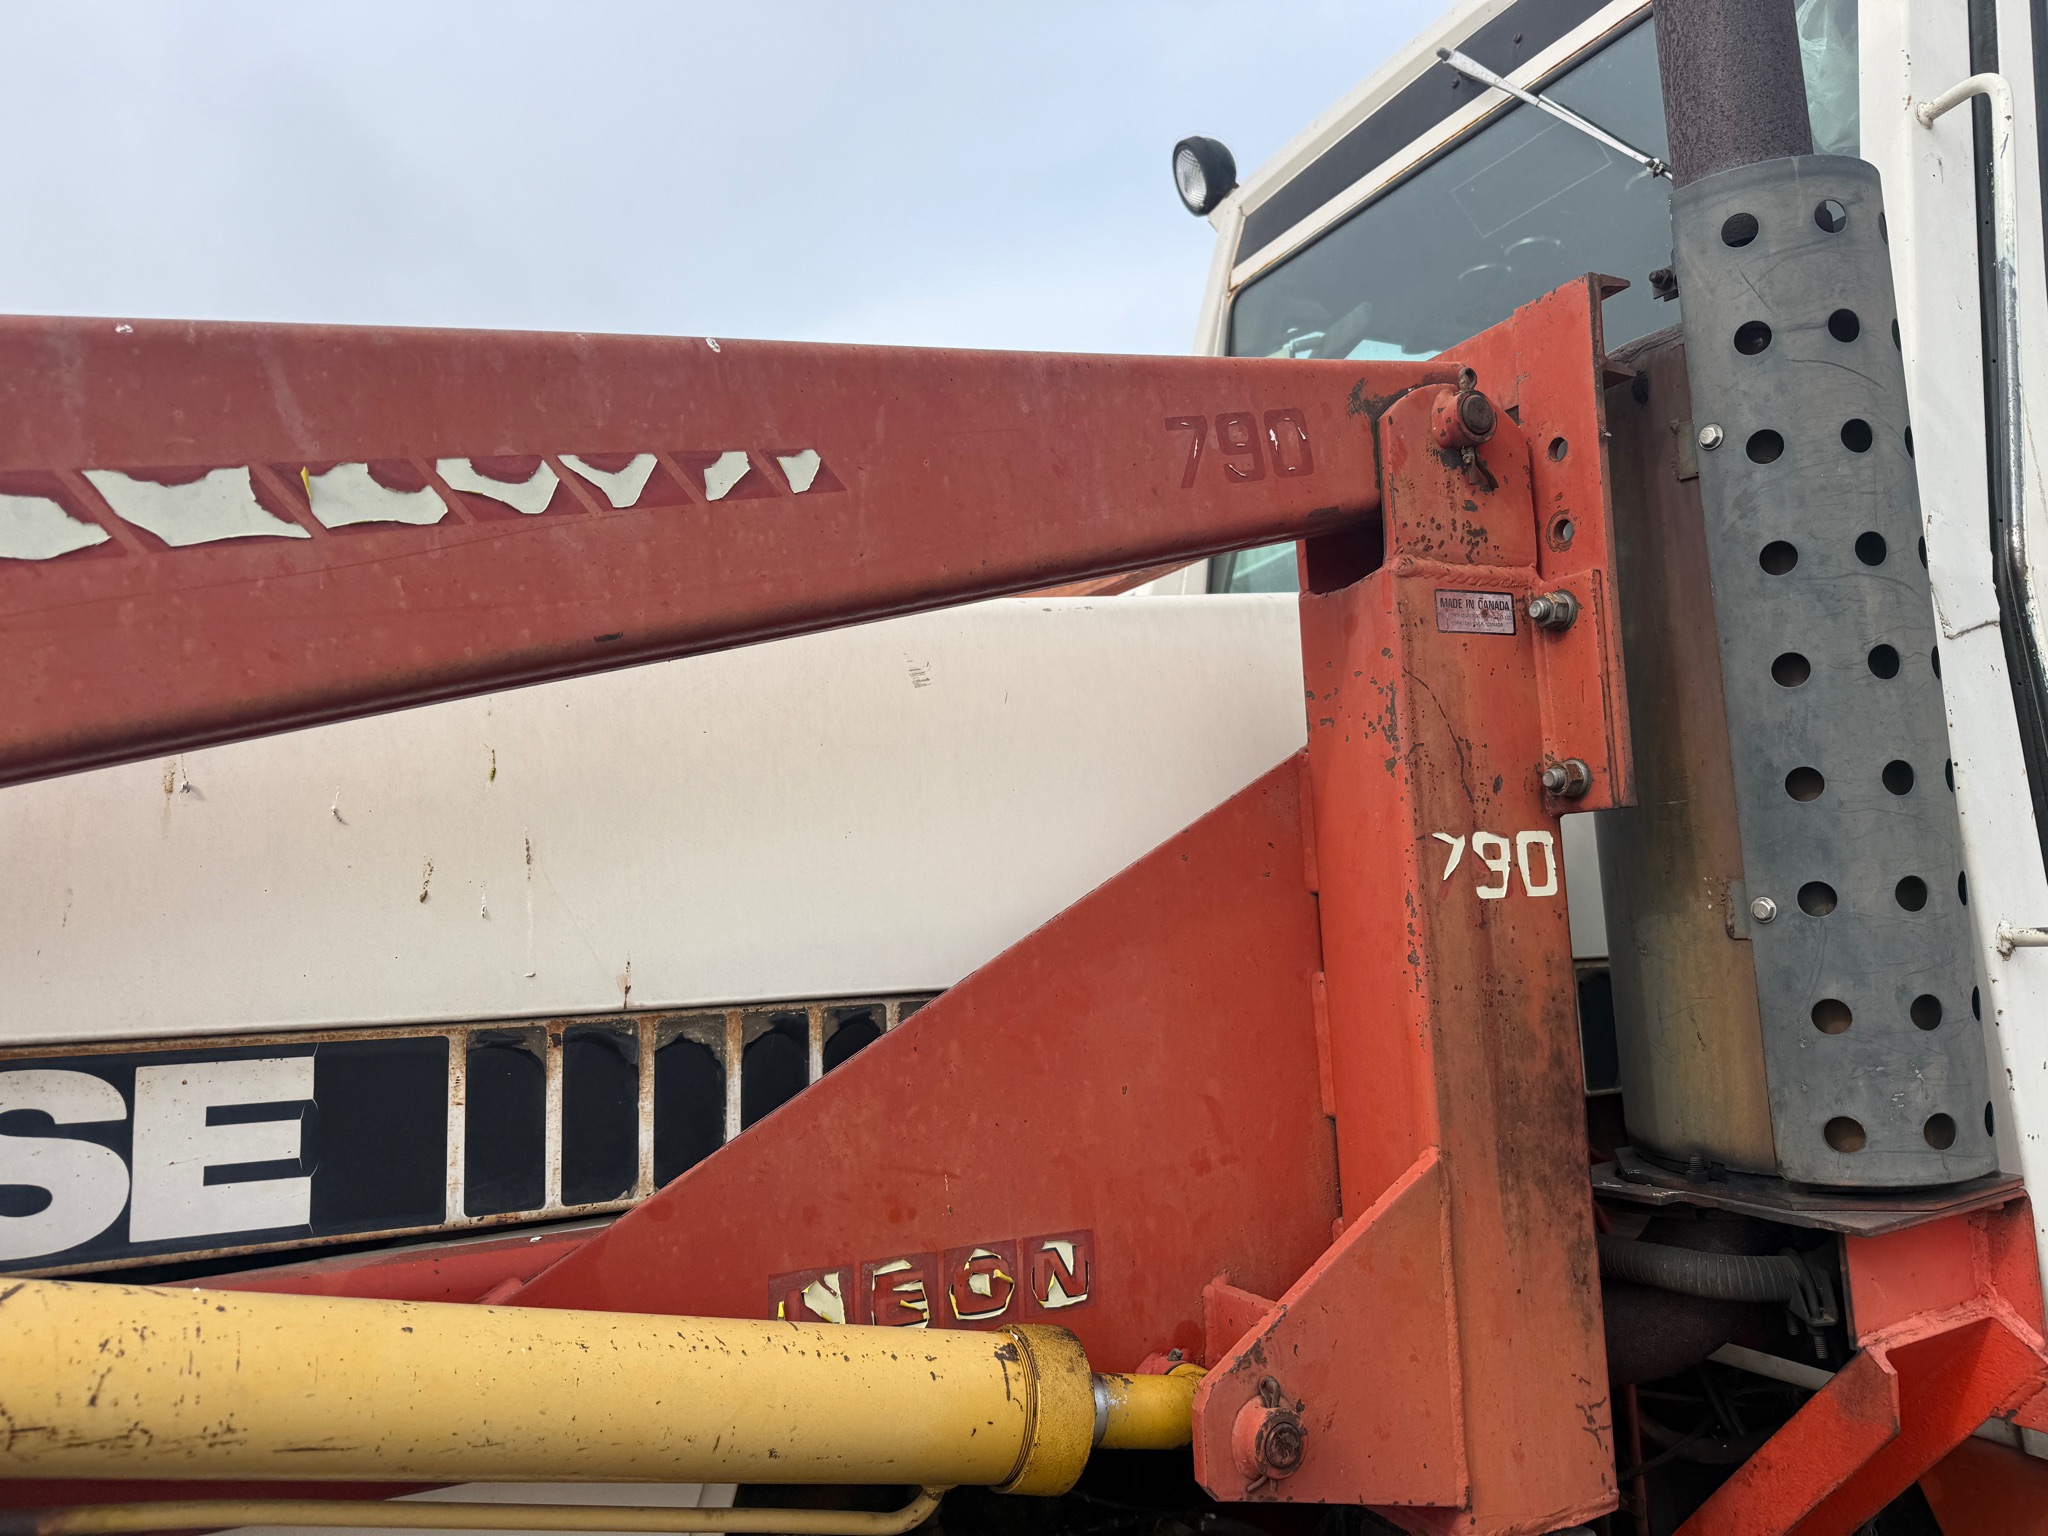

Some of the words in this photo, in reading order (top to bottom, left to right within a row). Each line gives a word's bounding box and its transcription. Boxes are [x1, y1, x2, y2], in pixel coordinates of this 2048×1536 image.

[1164, 408, 1314, 489] 790
[1439, 597, 1463, 609] MADE
[1465, 598, 1475, 610] IN
[1477, 598, 1510, 611] CANADA
[1431, 830, 1558, 899] 790
